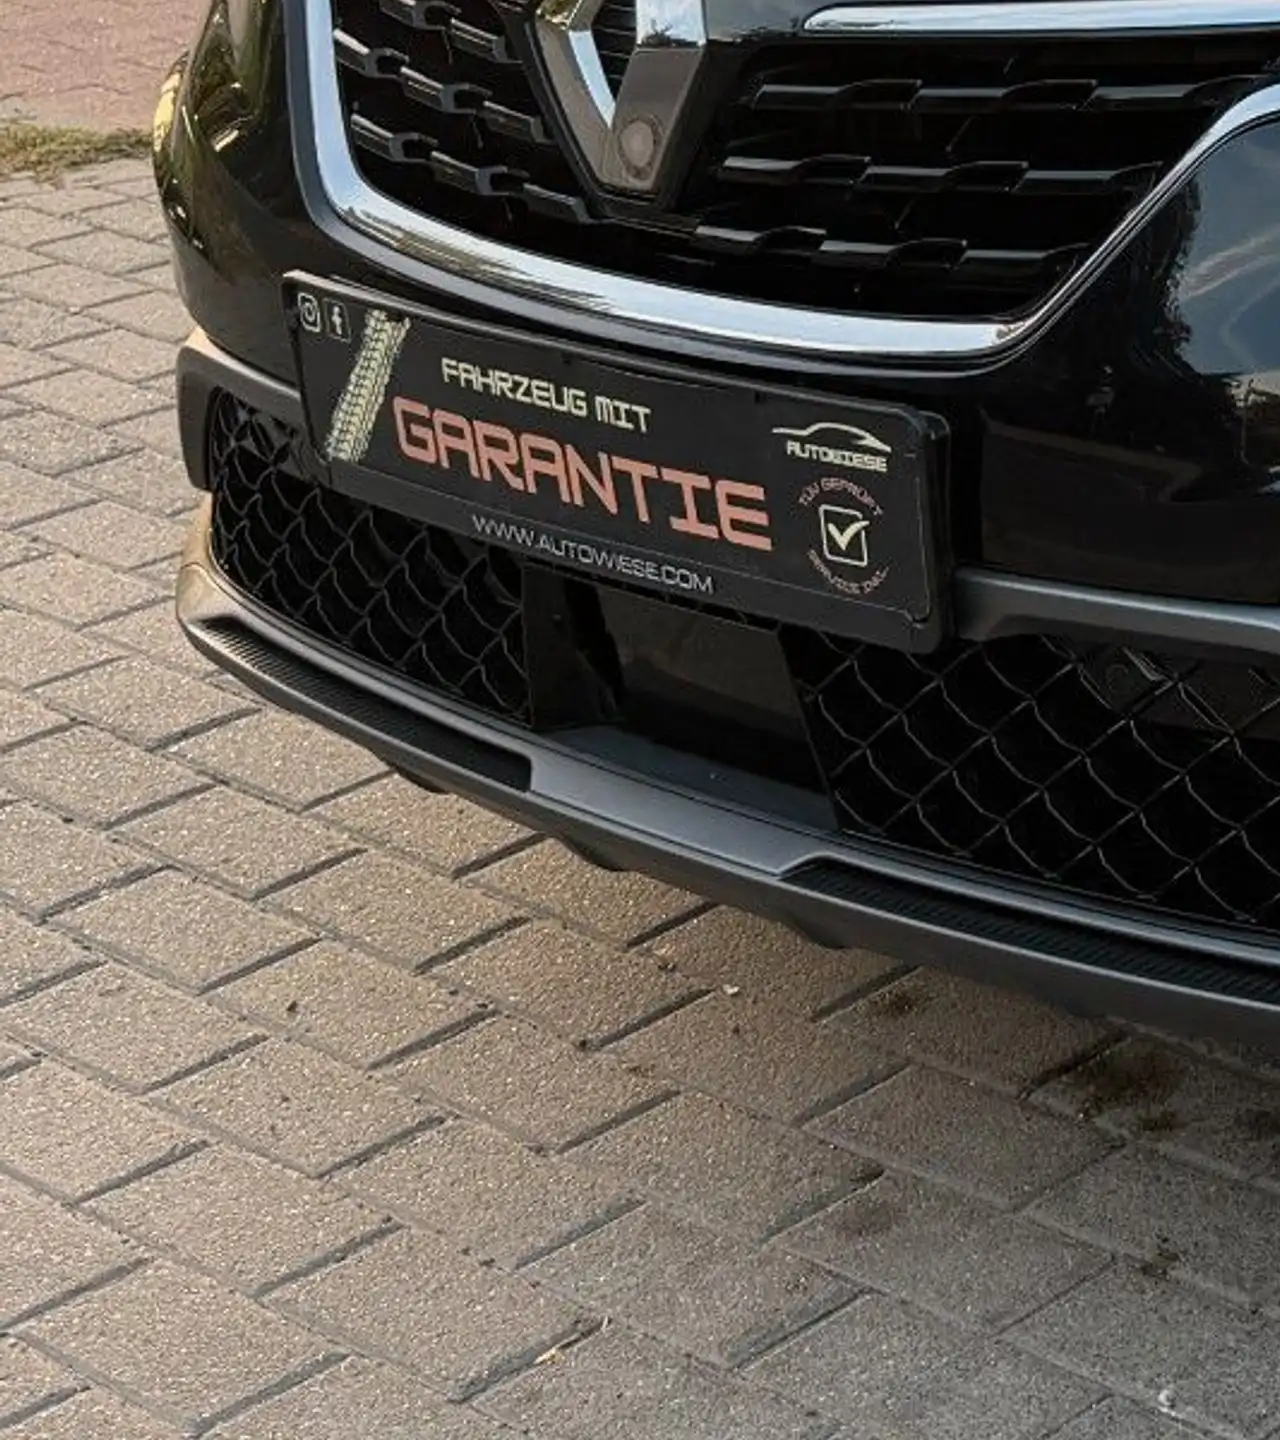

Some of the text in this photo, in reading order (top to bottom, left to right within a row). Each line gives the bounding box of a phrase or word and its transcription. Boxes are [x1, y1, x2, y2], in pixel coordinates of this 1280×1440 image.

[441, 357, 652, 434] FAHRZEUG MIT
[391, 395, 773, 552] GARANTIE
[786, 439, 888, 473] AUTOWIESE
[471, 513, 715, 596] WWW.AUTOWIESE.COM
